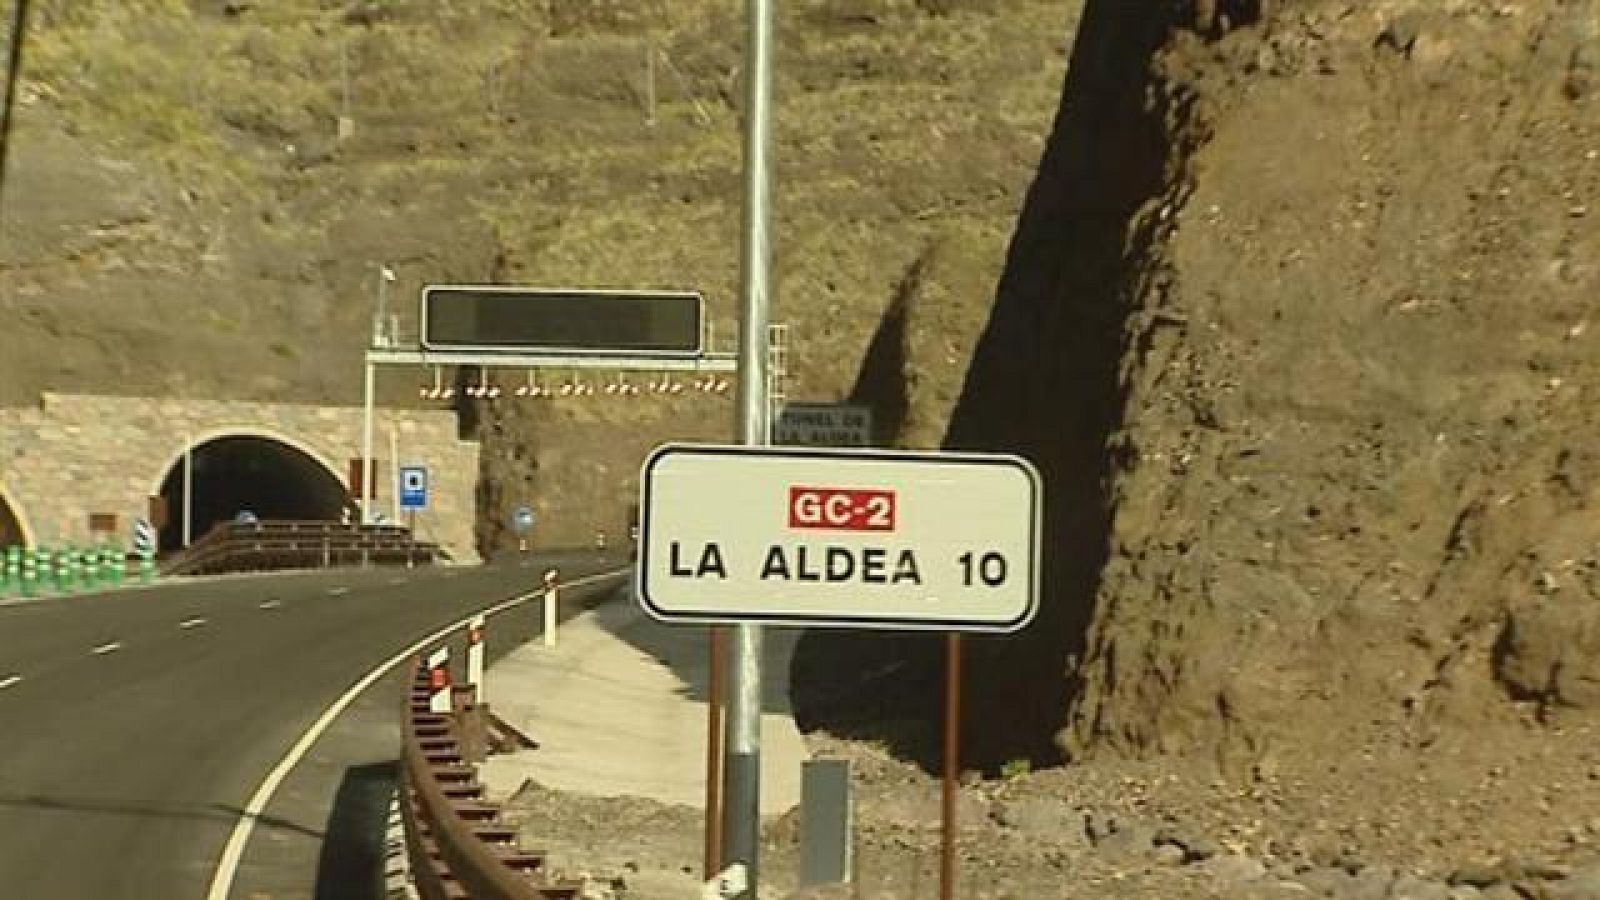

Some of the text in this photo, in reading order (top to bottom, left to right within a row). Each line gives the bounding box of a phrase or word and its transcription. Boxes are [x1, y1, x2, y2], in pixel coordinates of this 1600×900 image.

[794, 493, 892, 526] GC-2
[669, 542, 1008, 587] LA ALDEA 10
